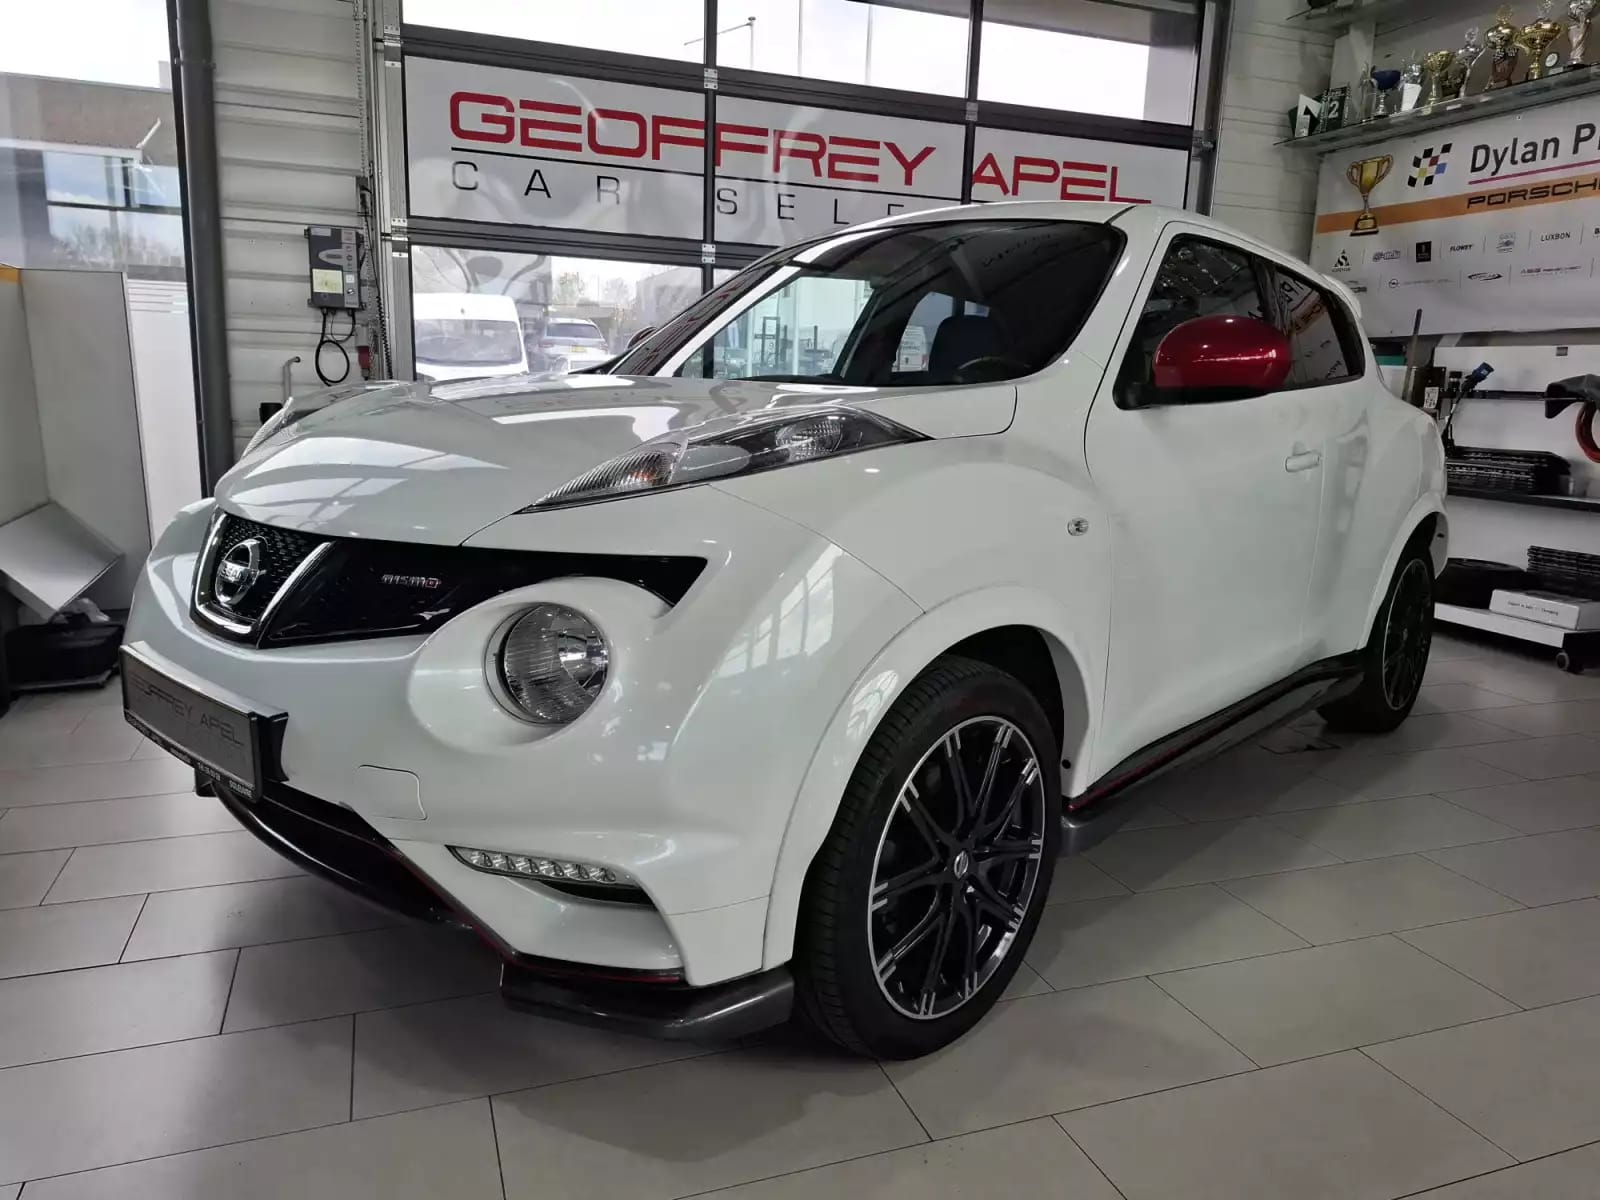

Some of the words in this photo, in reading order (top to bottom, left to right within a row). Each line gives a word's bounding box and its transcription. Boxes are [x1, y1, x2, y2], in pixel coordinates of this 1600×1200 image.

[450, 91, 936, 186] GEOFFREY
[971, 152, 1152, 204] APEL
[1470, 137, 1560, 177] Dylan
[1572, 122, 1600, 155] P
[452, 160, 624, 205] CAR
[1466, 177, 1600, 209] PORSCH
[1540, 231, 1571, 242] LUXBON
